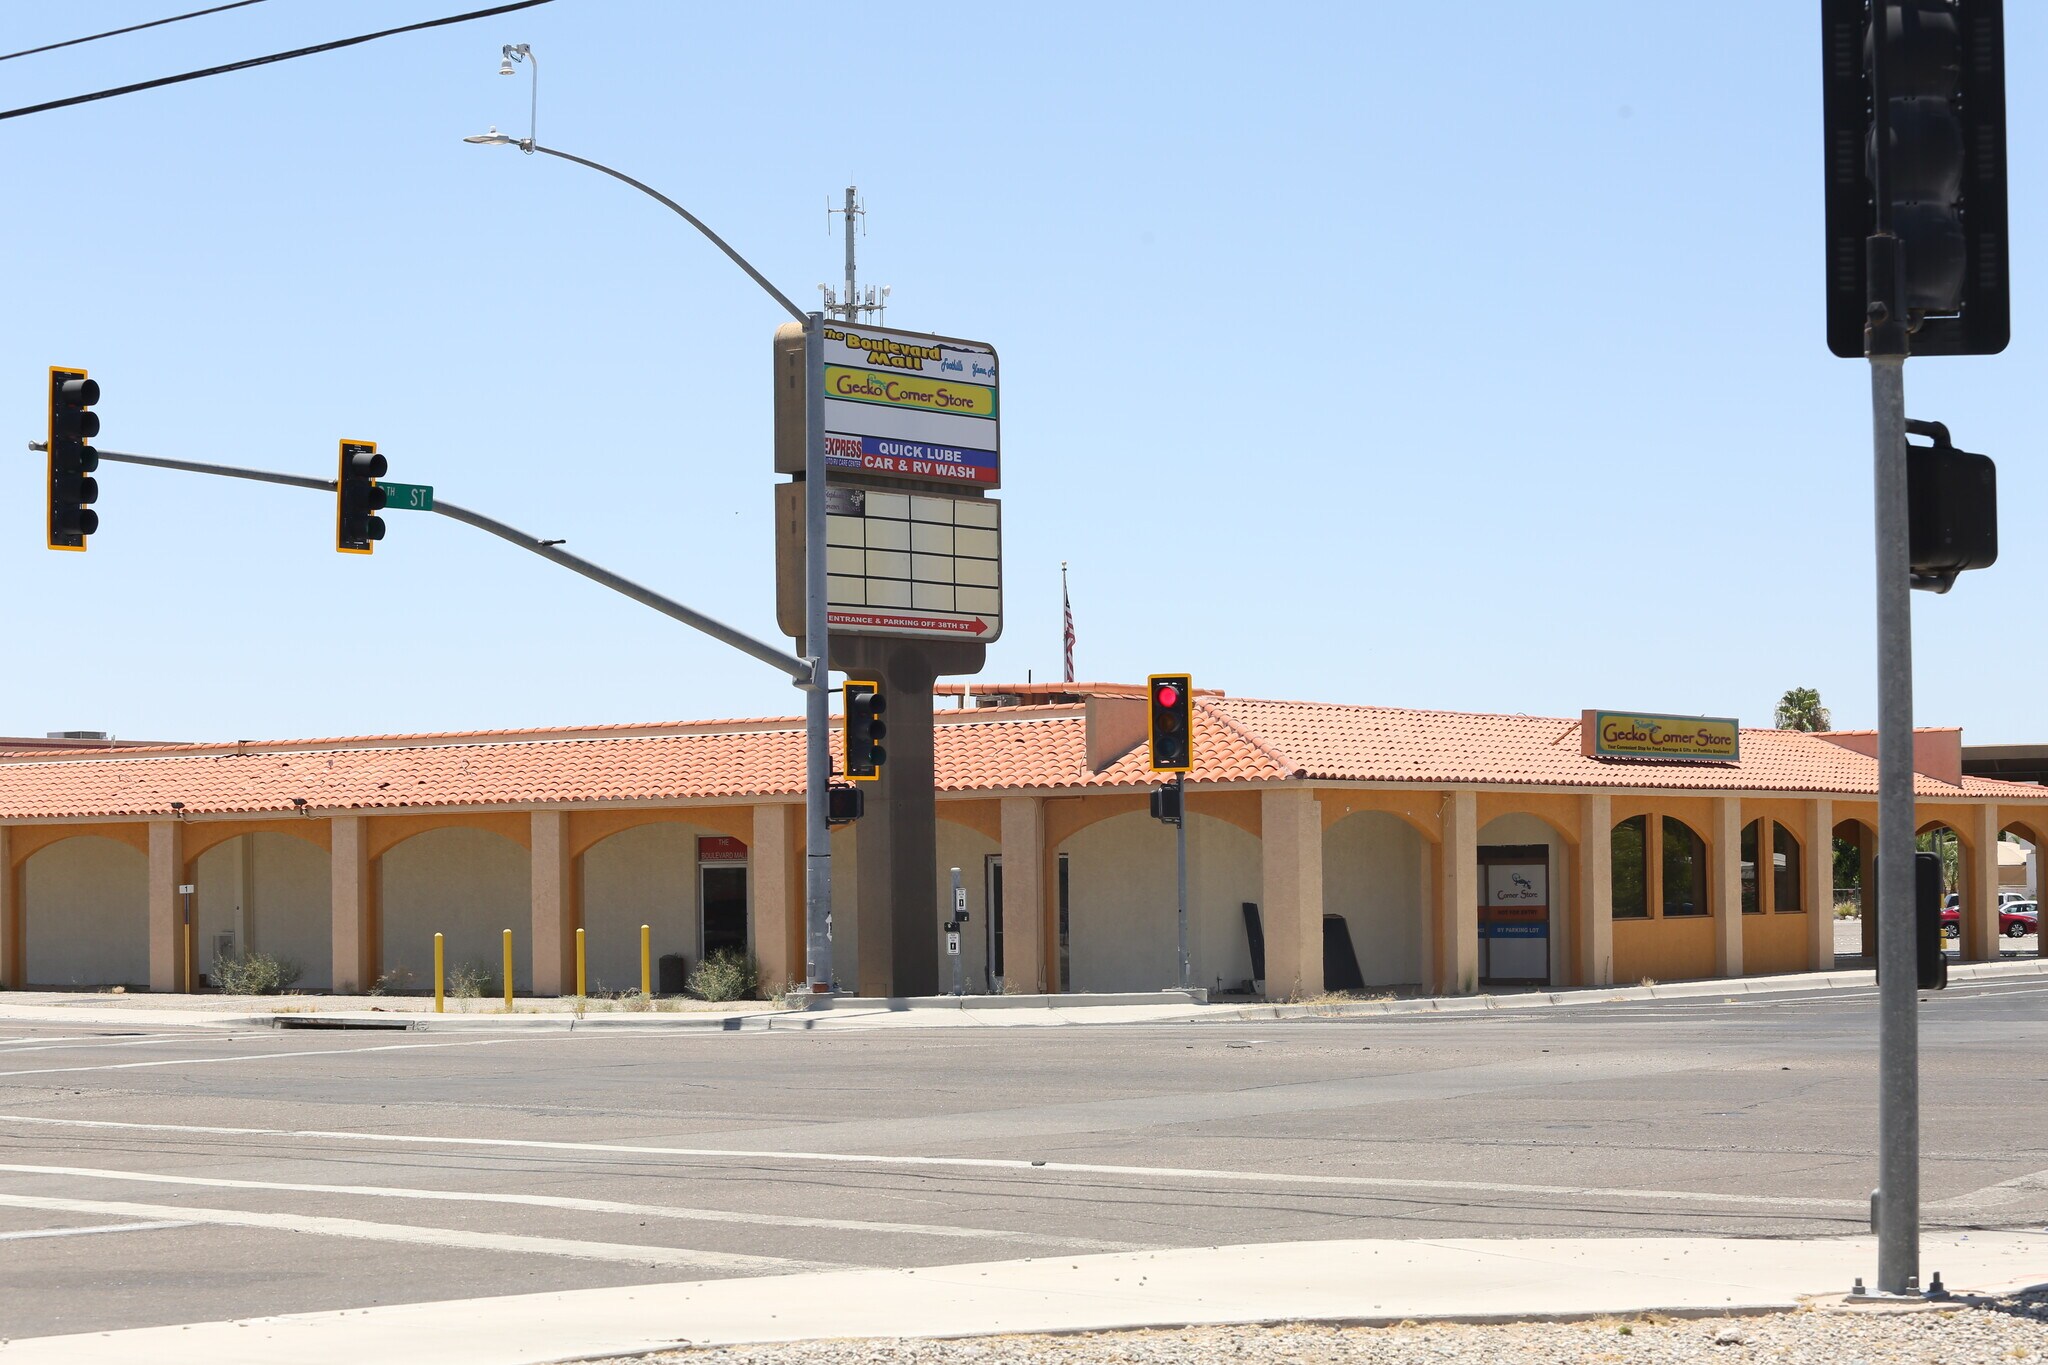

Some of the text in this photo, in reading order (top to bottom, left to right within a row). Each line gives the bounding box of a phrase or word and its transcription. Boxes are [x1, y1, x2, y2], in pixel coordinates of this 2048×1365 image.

[846, 334, 942, 361] Boulevard
[867, 350, 923, 371] Mall
[940, 357, 964, 373] Foothills
[836, 372, 974, 408] Gecko Corner Store
[825, 437, 862, 459] EXPRESS
[878, 441, 962, 463] QUICK LUBE
[864, 455, 976, 479] CAR & RV WASH
[410, 488, 427, 507] ST
[828, 615, 873, 624] ENTRANCE
[883, 619, 919, 627] PARKING
[937, 621, 958, 629] 38TH
[1603, 723, 1732, 747] Gecko Corner Store
[184, 885, 188, 893] 1
[1497, 889, 1538, 900] Corner Store
